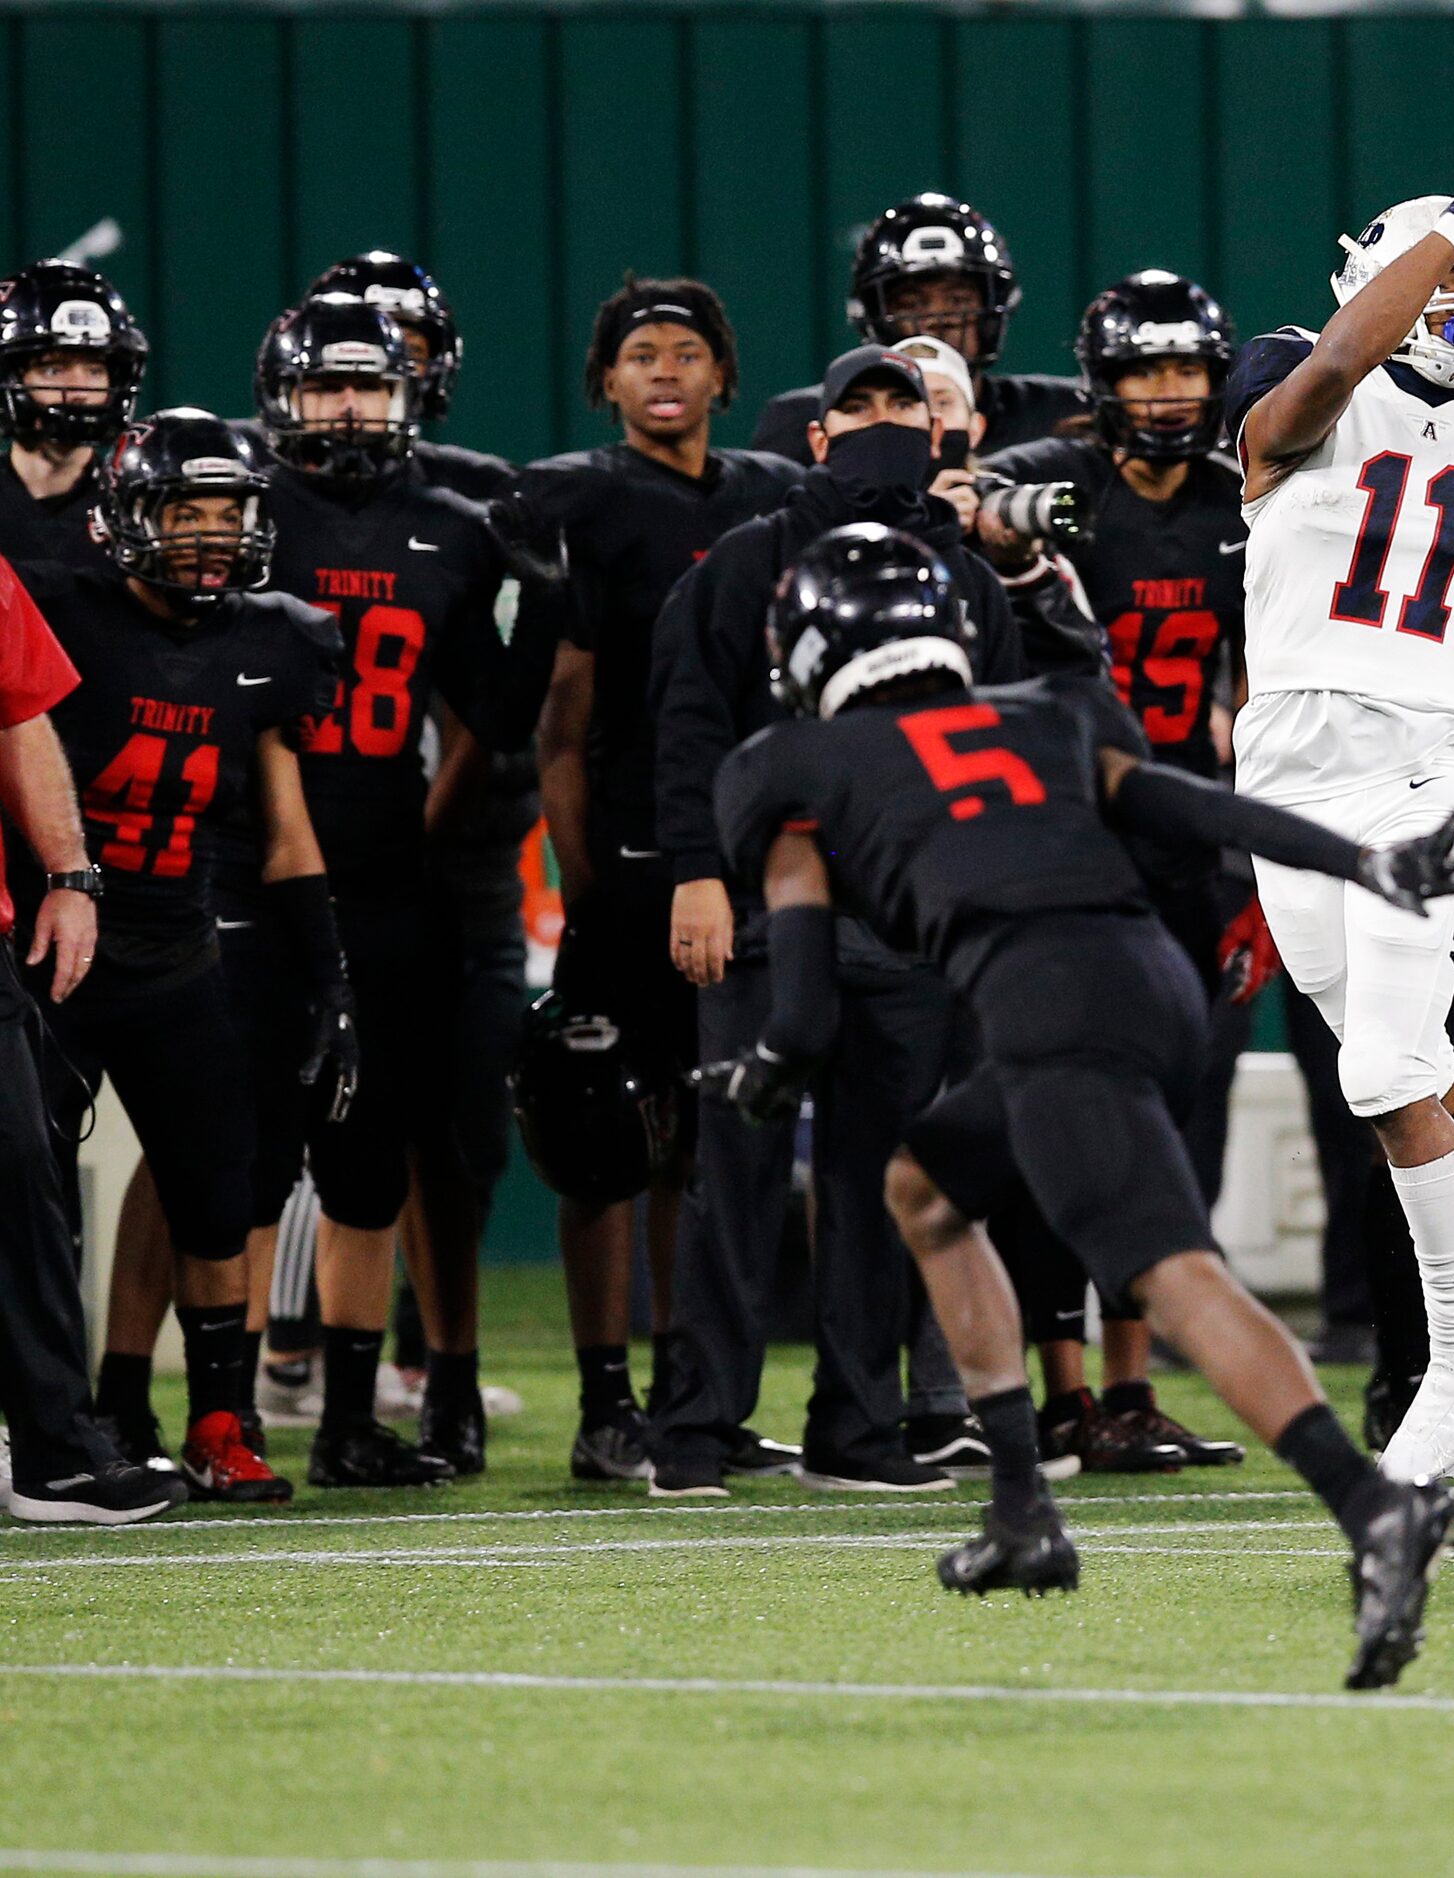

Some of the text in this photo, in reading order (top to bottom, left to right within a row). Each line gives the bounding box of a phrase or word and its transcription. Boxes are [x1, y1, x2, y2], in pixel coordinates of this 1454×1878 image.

[1421, 421, 1438, 441] A
[315, 568, 398, 600] TRINITY
[1132, 577, 1206, 609] TRINITY
[130, 696, 216, 736] TRINITY
[896, 703, 1047, 821] 5
[84, 733, 221, 877] 41
